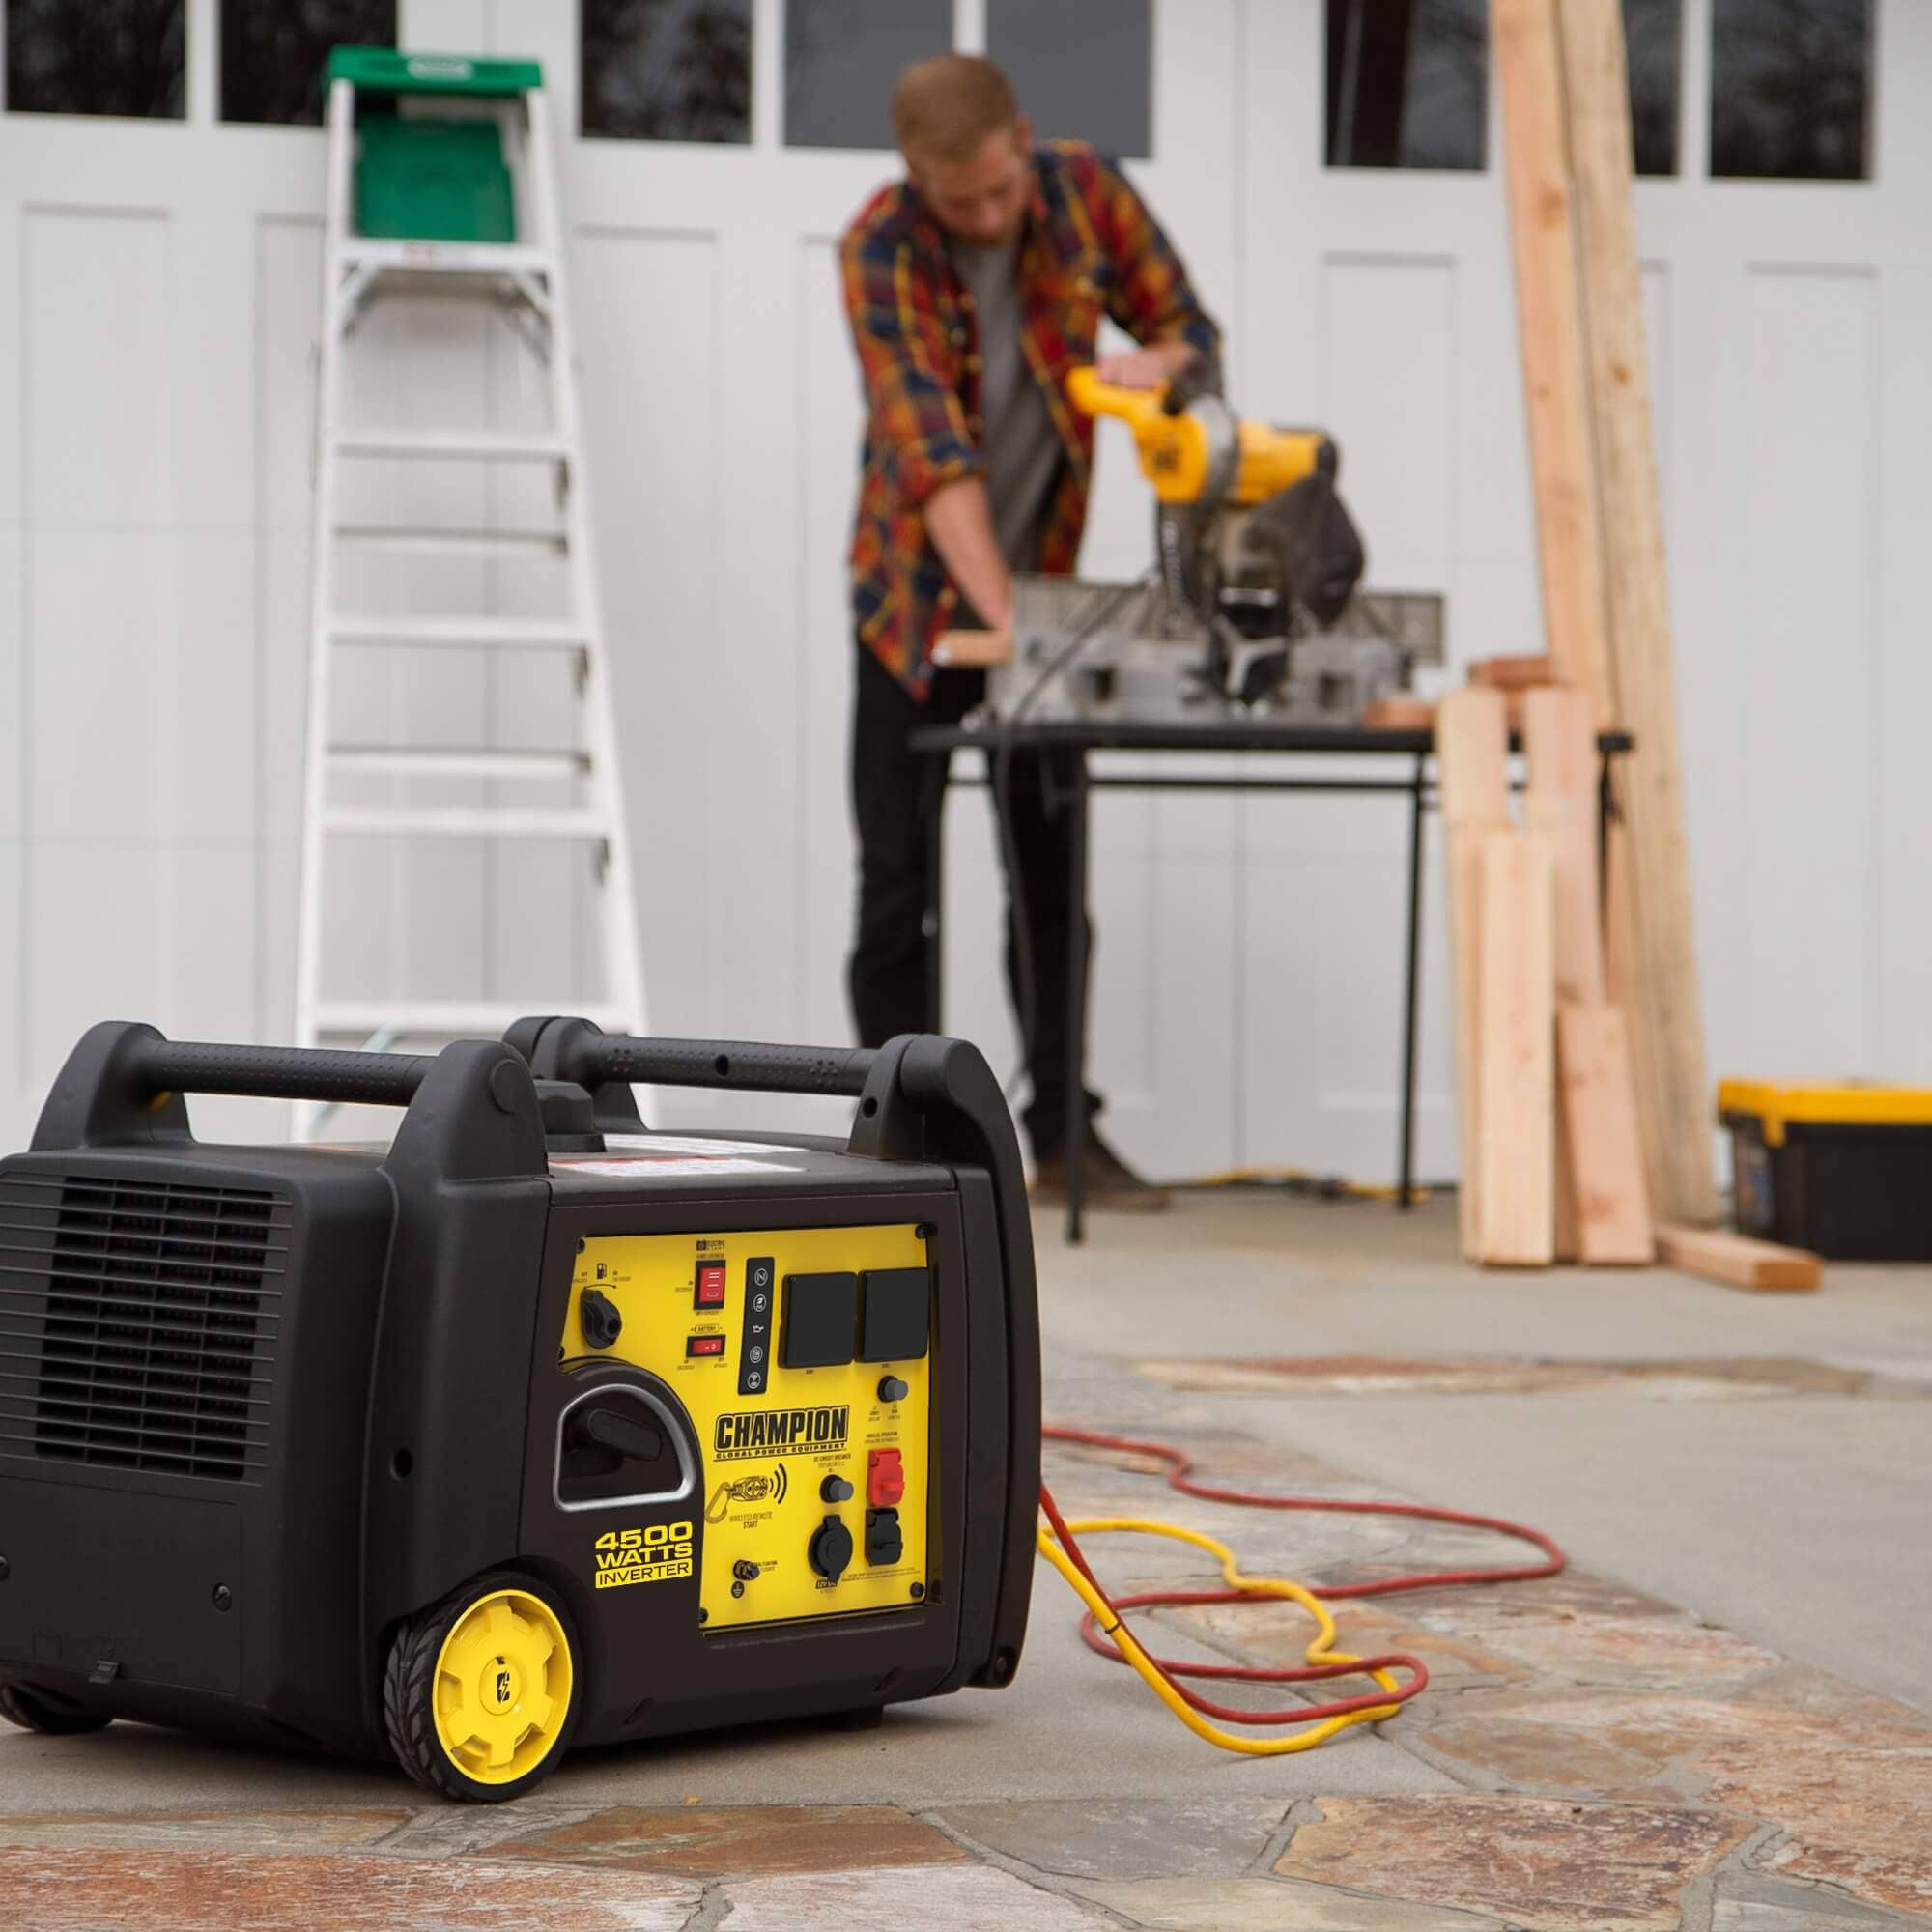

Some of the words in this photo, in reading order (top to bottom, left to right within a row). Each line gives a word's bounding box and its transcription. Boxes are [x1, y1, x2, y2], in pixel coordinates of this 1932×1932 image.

[716, 1406, 848, 1451] CHAMPION
[716, 1450, 752, 1459] GLOBAL
[755, 1447, 787, 1456] POWER
[791, 1443, 845, 1452] EQUIPMENT
[595, 1521, 693, 1550] 4500
[595, 1542, 693, 1569] WATTS
[599, 1562, 689, 1585] INVERTER
